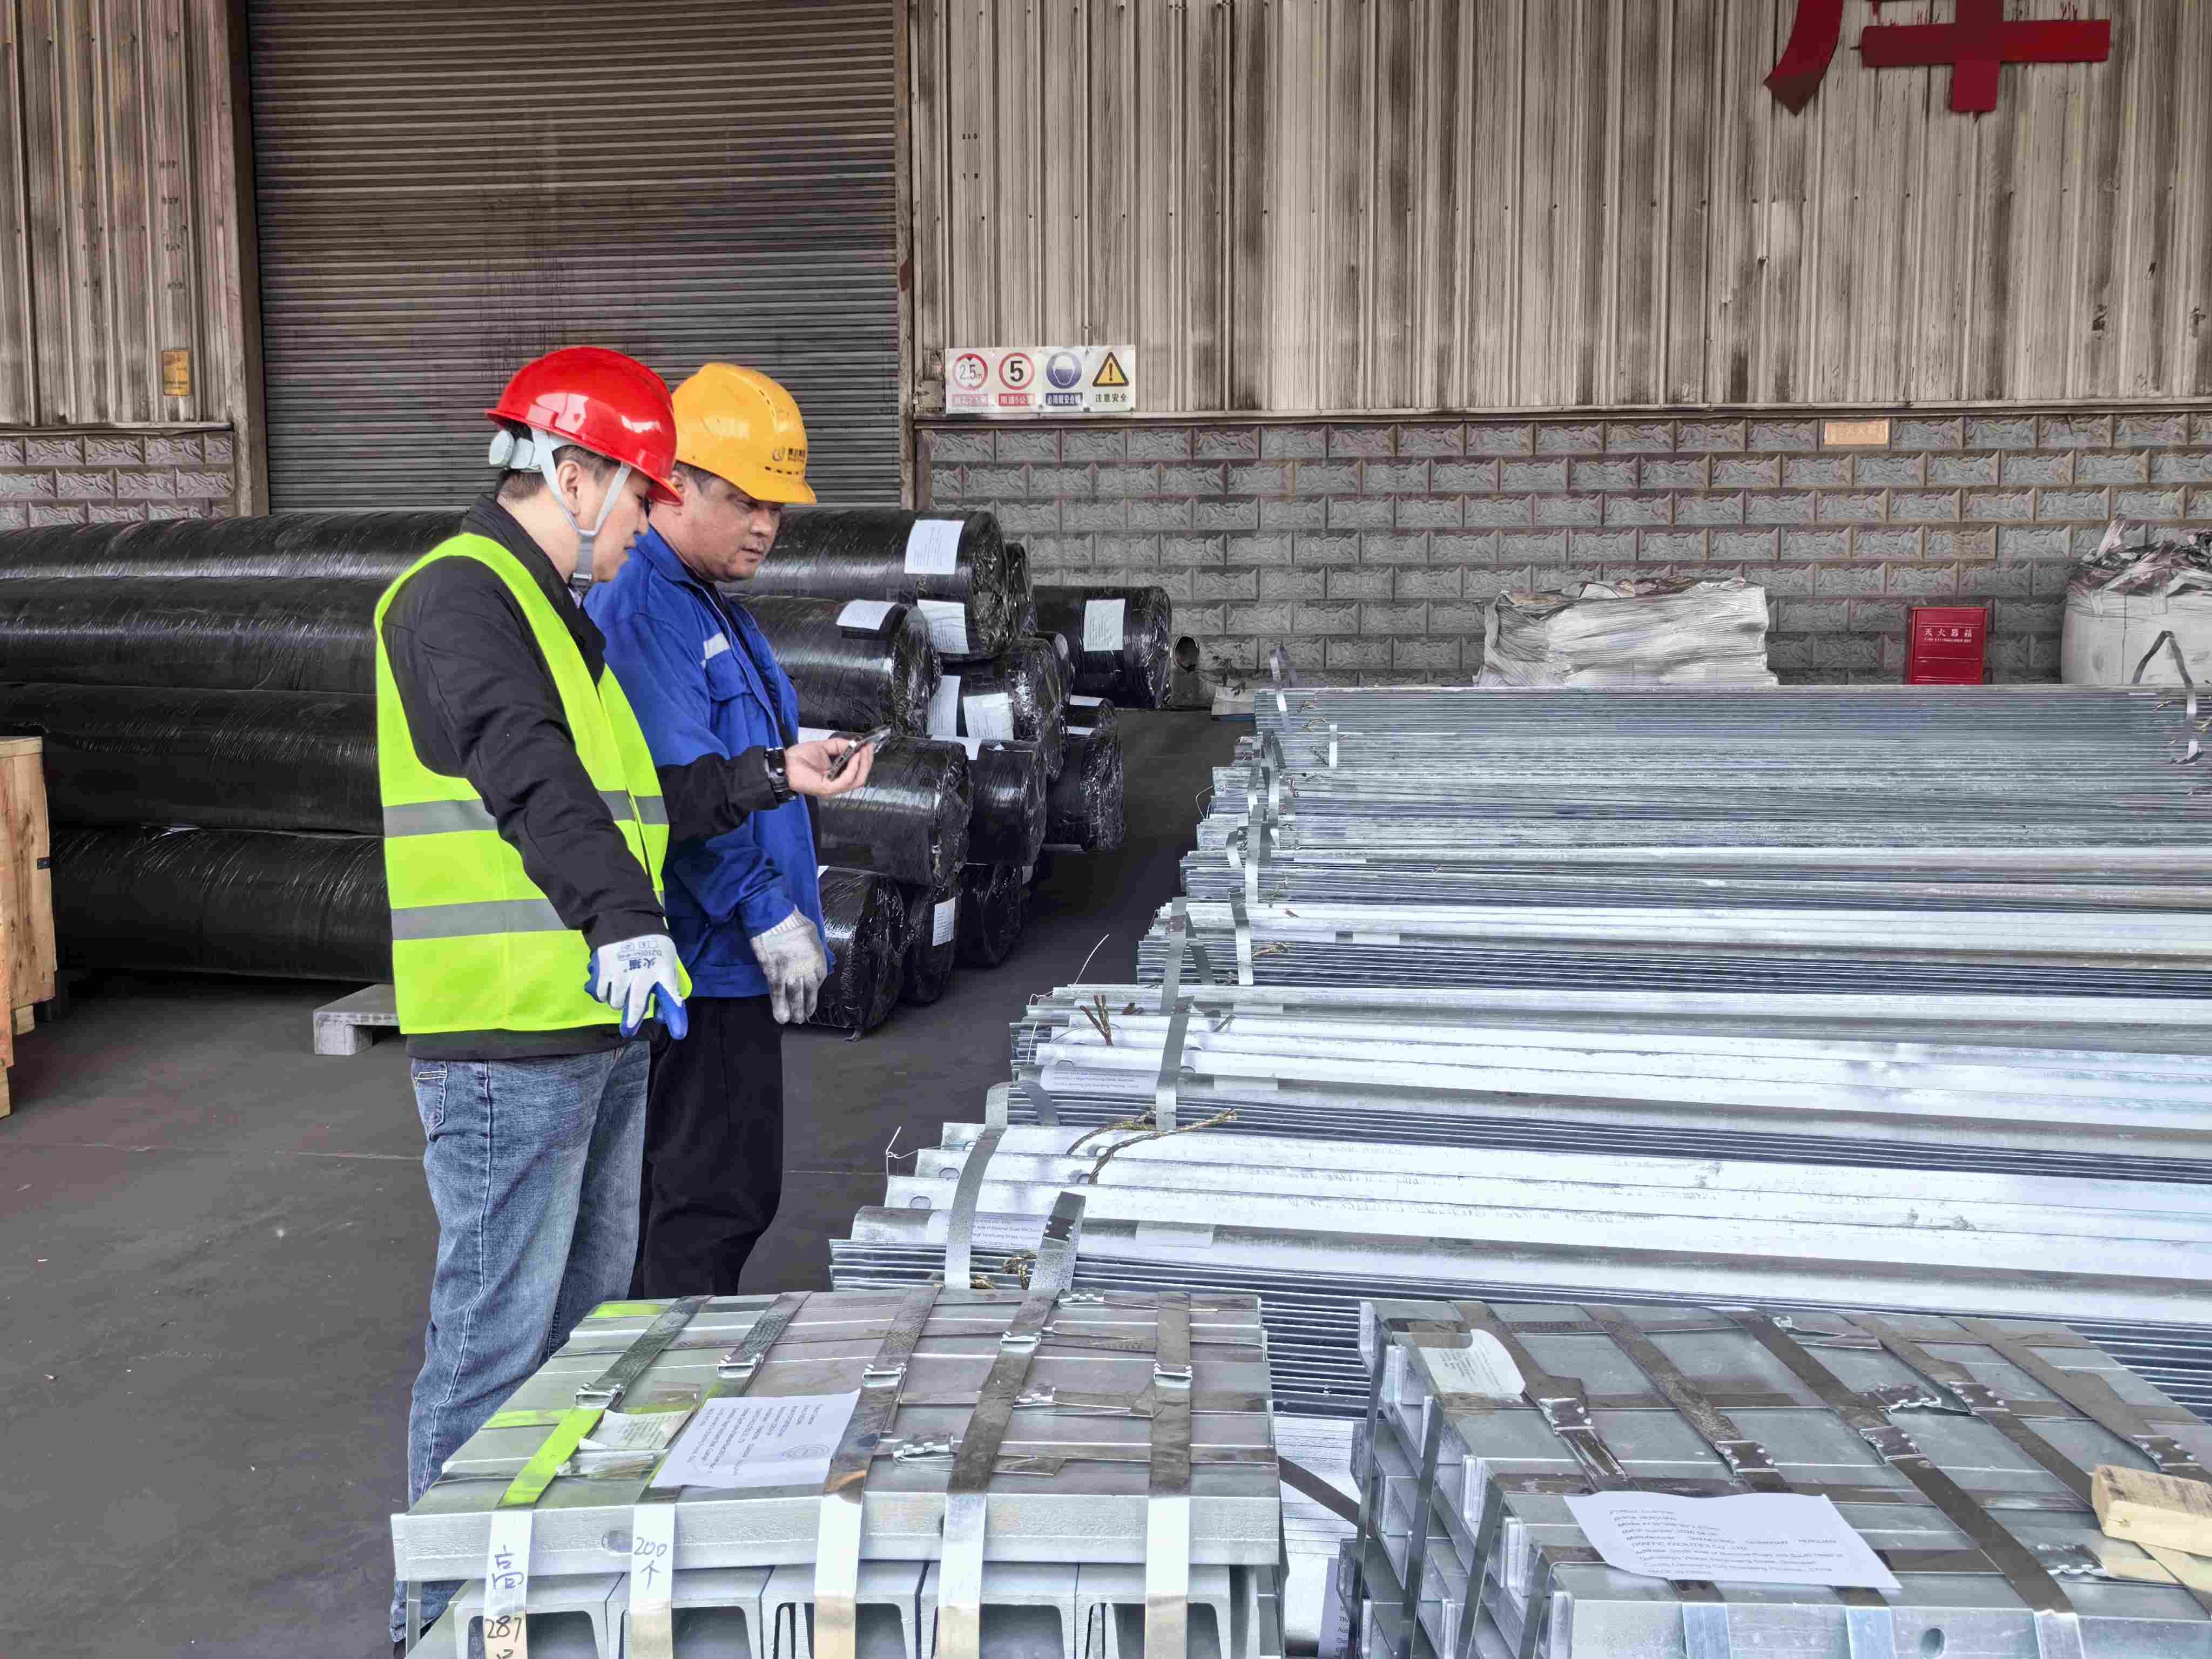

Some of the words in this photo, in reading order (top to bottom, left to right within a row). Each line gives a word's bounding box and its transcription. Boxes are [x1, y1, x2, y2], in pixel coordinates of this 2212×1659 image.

[1010, 361, 1023, 382] 5
[1095, 393, 1128, 403] 注意安全
[633, 1536, 668, 1557] 200
[485, 1615, 522, 1643] 287
